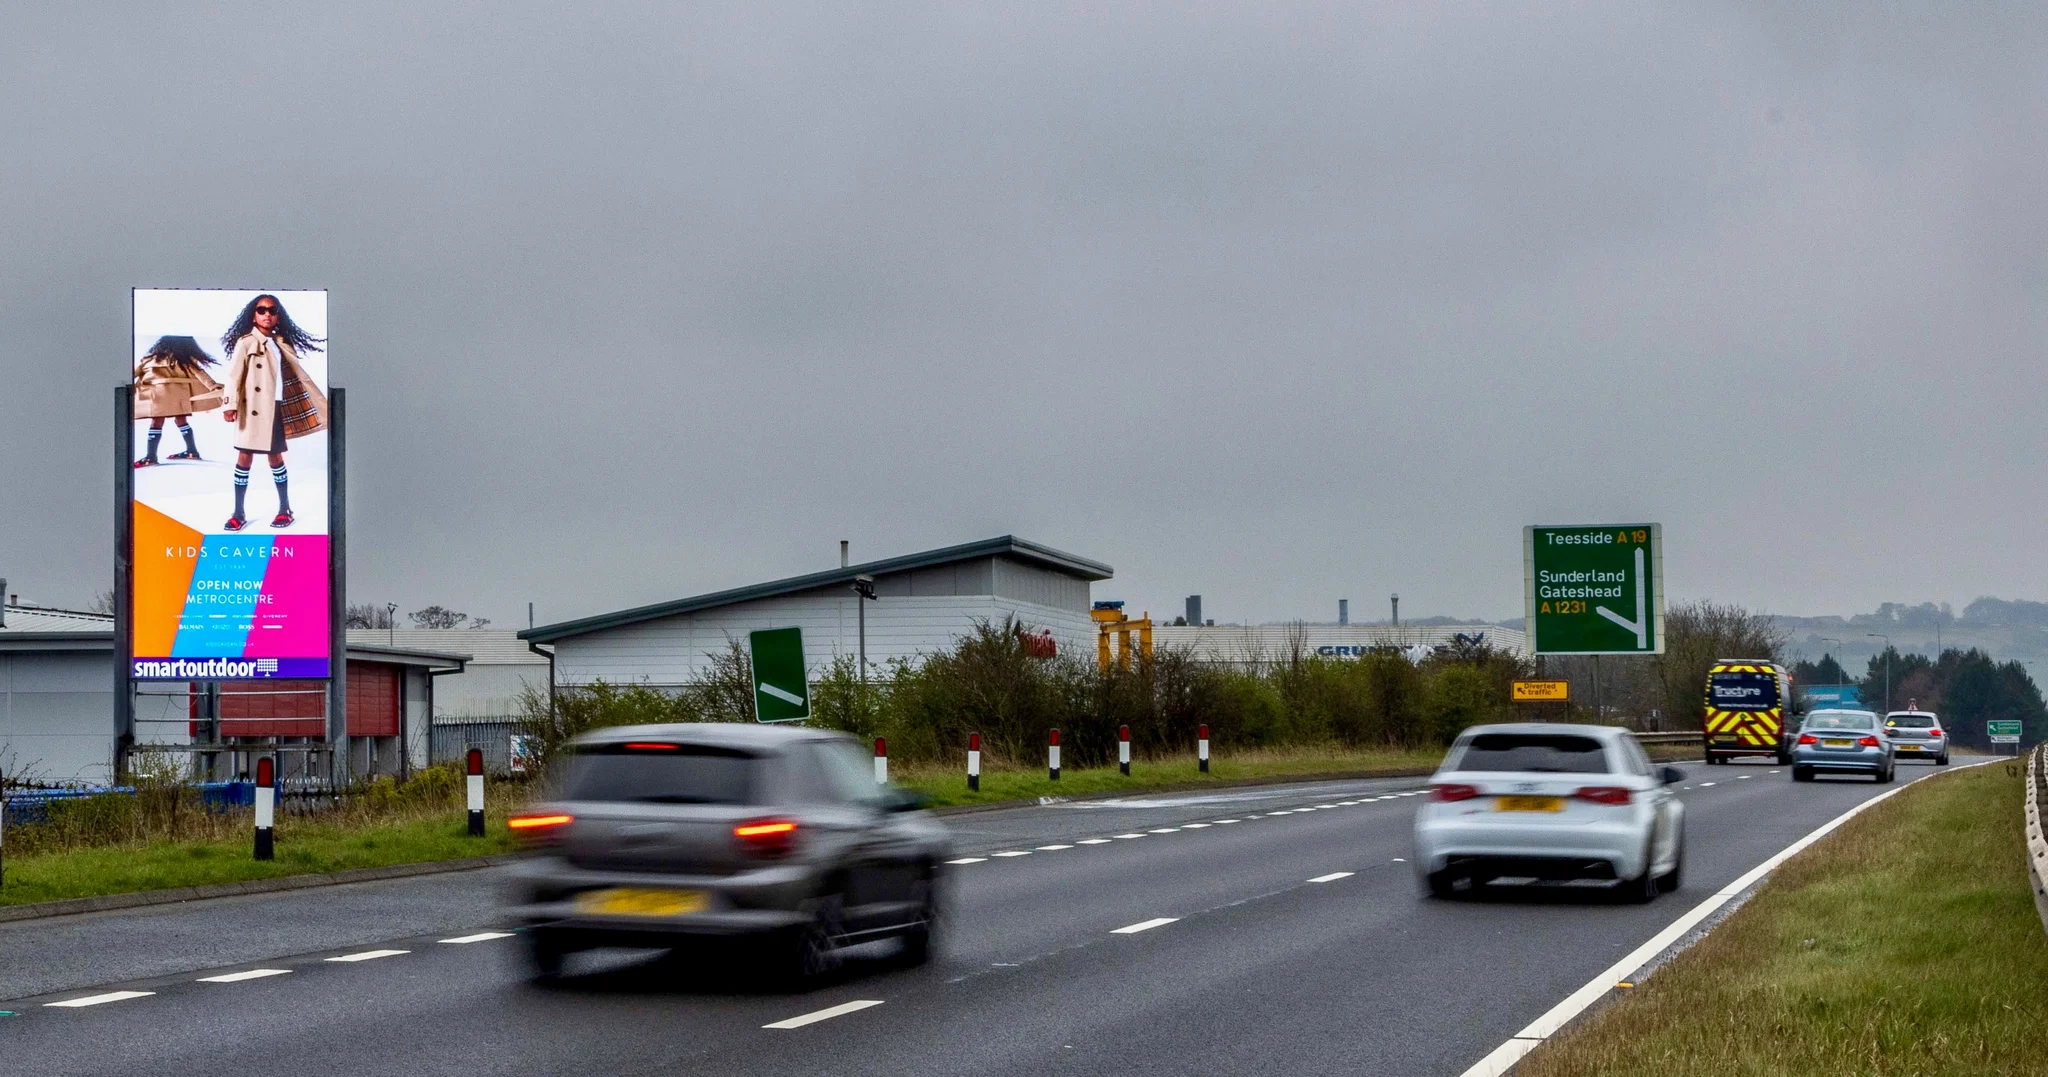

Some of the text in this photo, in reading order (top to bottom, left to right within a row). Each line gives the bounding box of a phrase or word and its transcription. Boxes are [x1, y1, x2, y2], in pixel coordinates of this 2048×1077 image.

[1546, 530, 1647, 545] Teesside A 19
[165, 546, 294, 558] KIDS CAVERN
[1539, 569, 1625, 583] Sunderland
[197, 580, 264, 590] OPEN NOW
[1539, 585, 1622, 599] Gateshead
[186, 594, 274, 605] METROCENTRE
[1540, 601, 1586, 614] A 1231
[134, 657, 257, 677] smartoutdoor
[1524, 682, 1557, 690] Diverted
